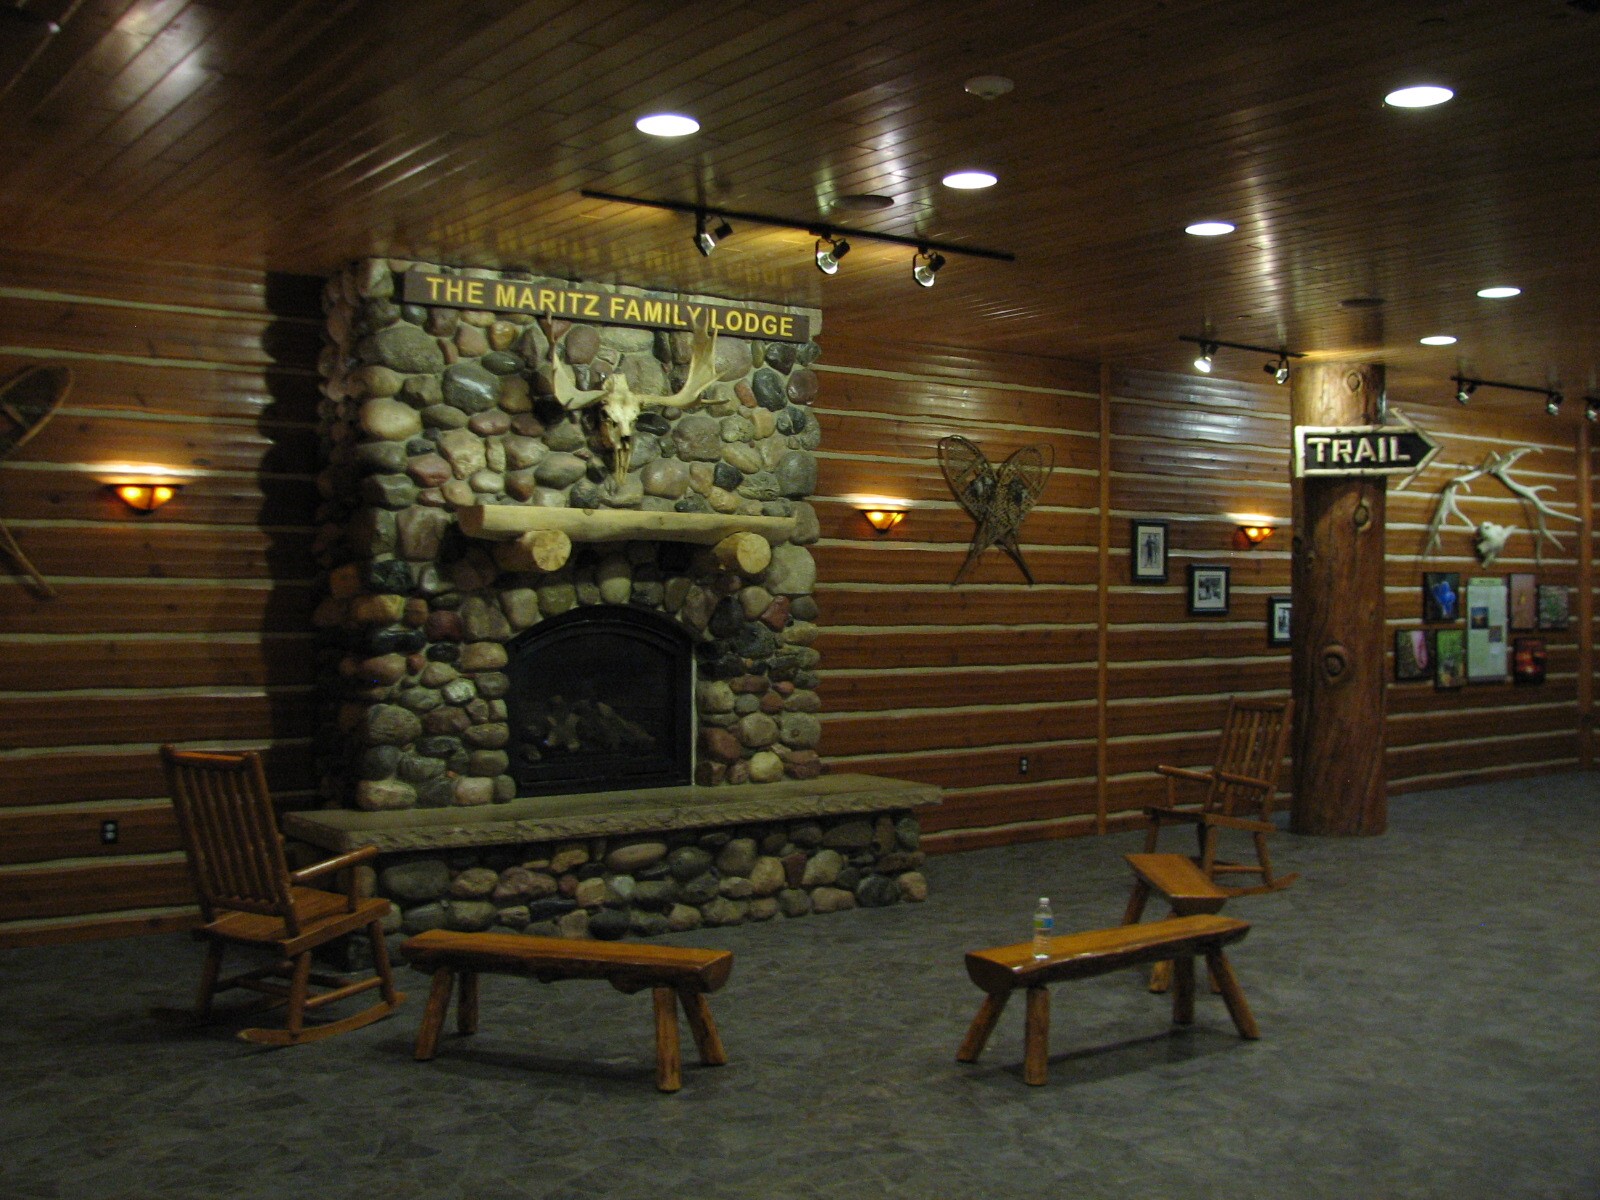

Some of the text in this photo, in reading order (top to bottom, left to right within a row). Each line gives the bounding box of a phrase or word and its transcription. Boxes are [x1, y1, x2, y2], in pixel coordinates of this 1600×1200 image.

[427, 277, 485, 304] THE
[495, 284, 600, 317] MARITZ
[711, 309, 794, 337] LODGE
[1307, 436, 1411, 464] TRAIL
